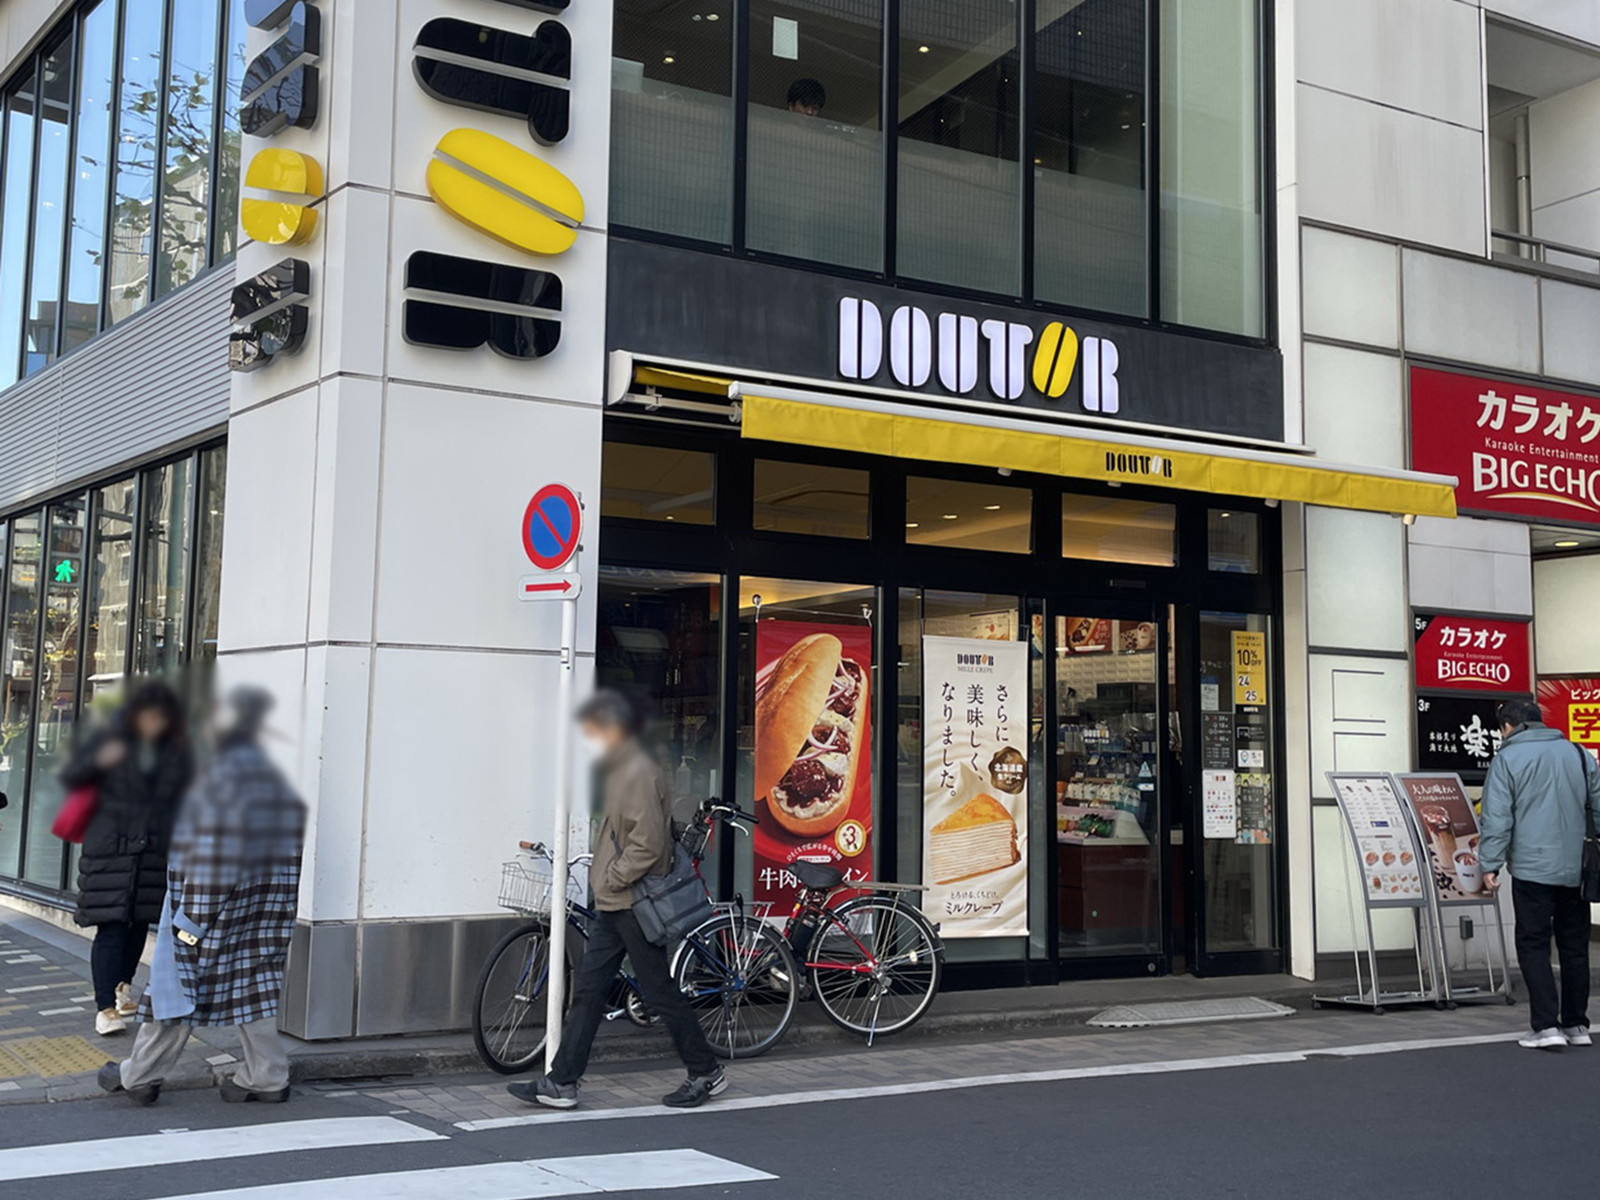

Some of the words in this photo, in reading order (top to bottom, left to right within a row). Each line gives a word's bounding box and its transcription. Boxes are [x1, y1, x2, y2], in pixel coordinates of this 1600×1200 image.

[838, 296, 1120, 414] DOUTOR
[1476, 390, 1600, 443] カラオケ
[1485, 437, 1525, 454] Karaoke
[1529, 443, 1599, 464] Entertainment
[1106, 452, 1172, 478] DOUTOR
[1473, 452, 1529, 492] BIG
[1415, 617, 1428, 630] 5F
[1439, 626, 1507, 649] カラオケ
[1238, 675, 1250, 686] 24
[1437, 659, 1467, 679] BIG
[1469, 662, 1511, 683] ECHO
[1245, 690, 1258, 702] 25
[1417, 699, 1430, 712] 3F
[995, 685, 1010, 744] さらに
[940, 682, 957, 798] なりました。
[965, 684, 985, 782] 美味しく、
[945, 900, 1004, 915] ミルクレープ
